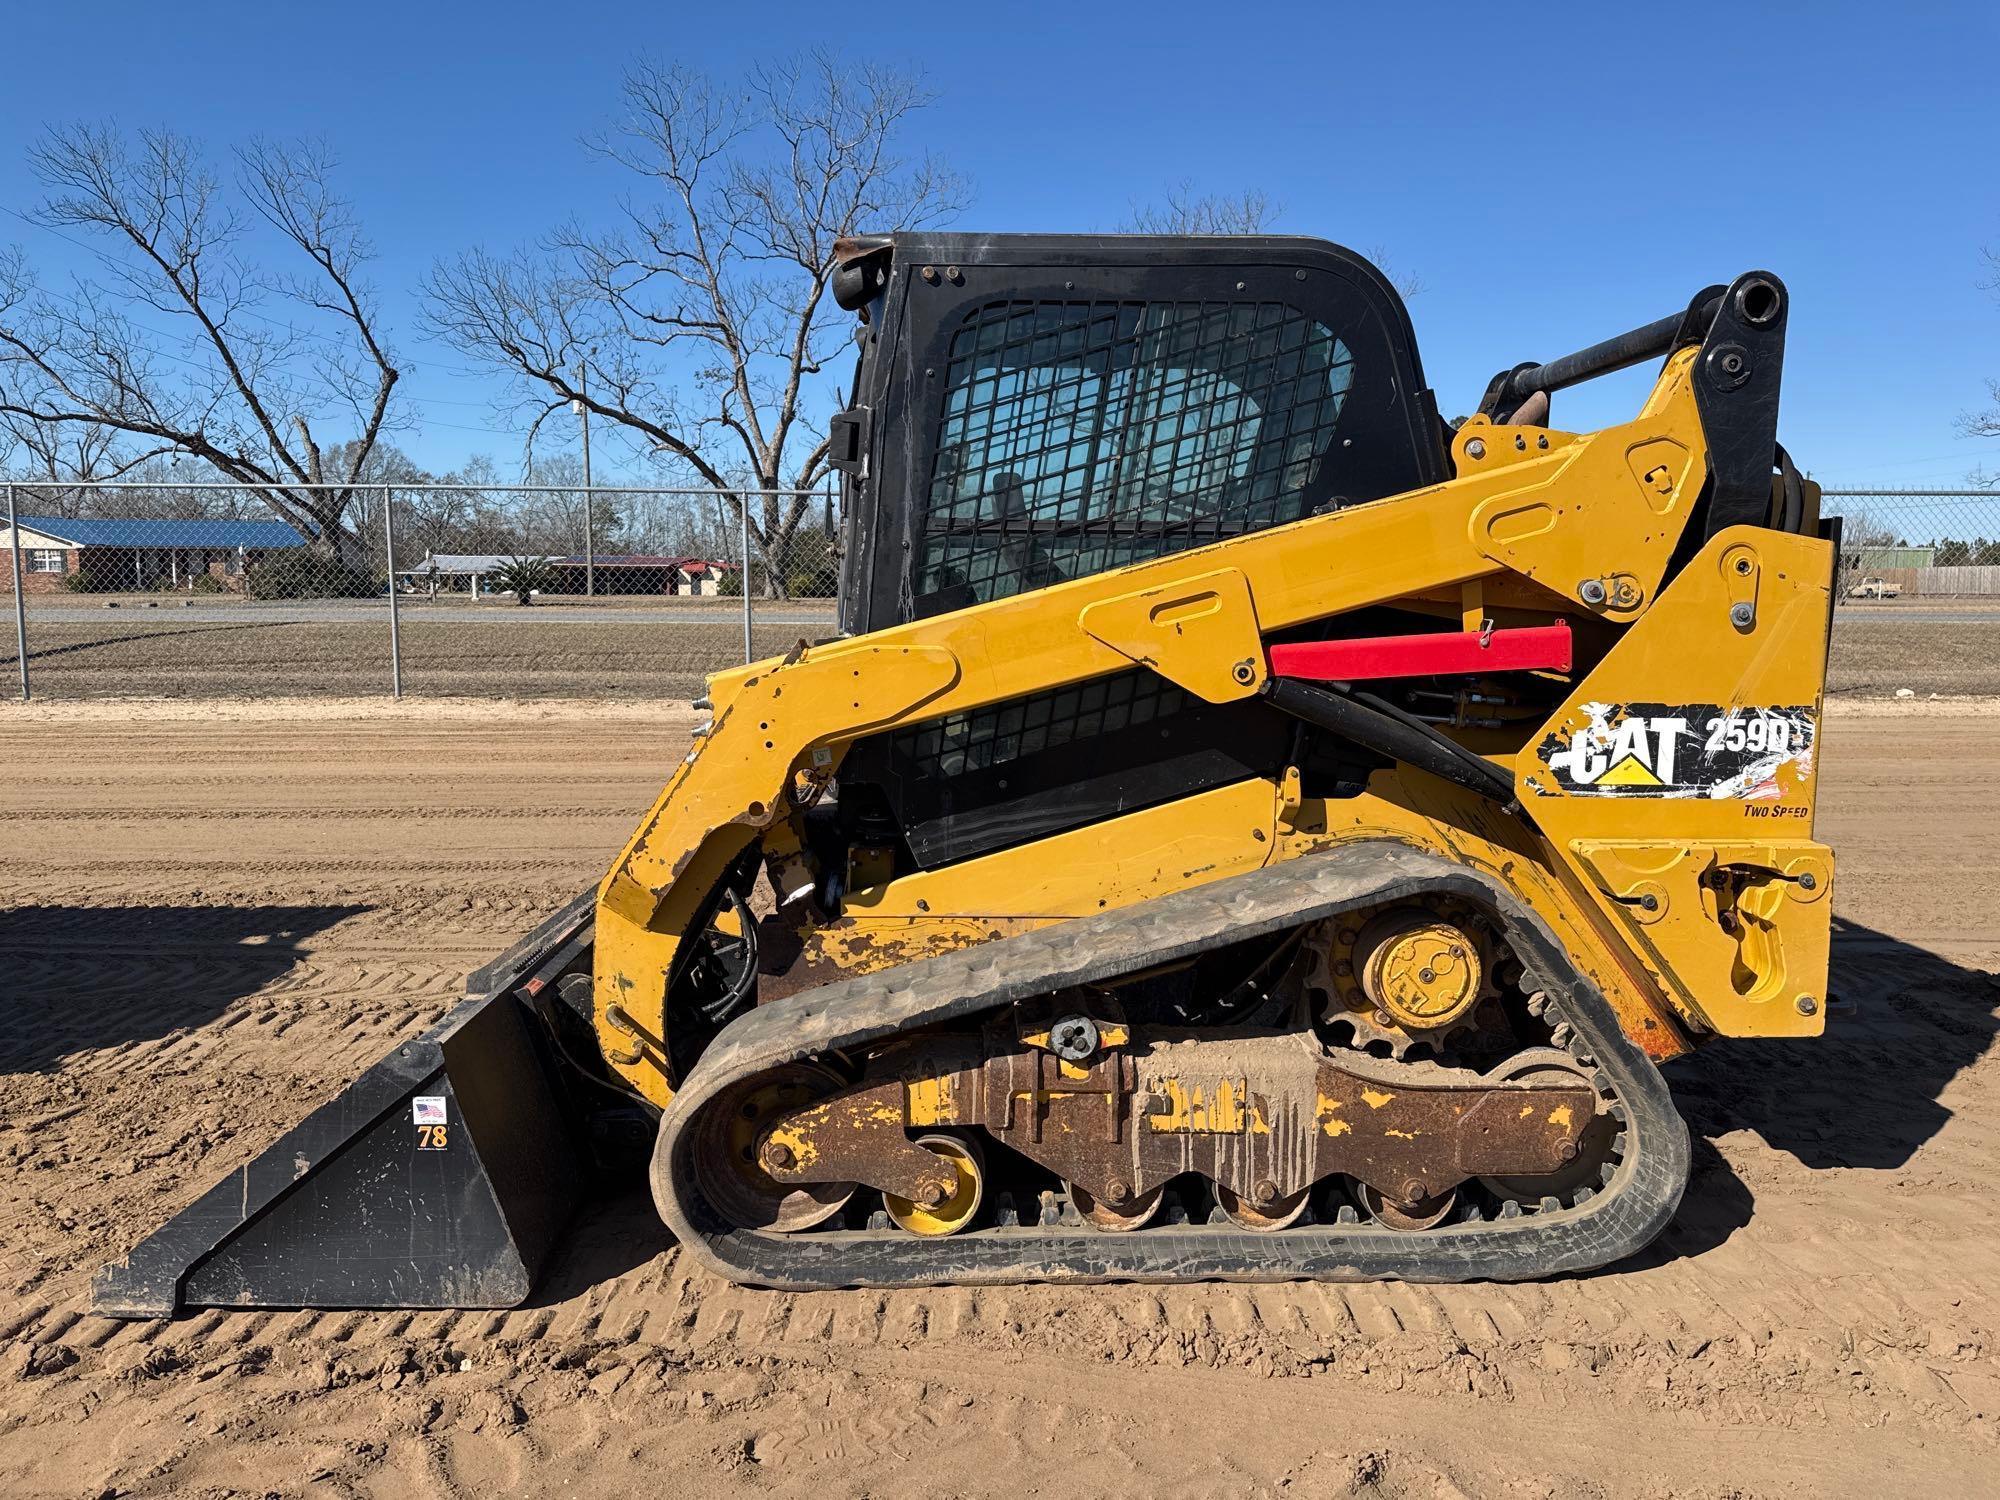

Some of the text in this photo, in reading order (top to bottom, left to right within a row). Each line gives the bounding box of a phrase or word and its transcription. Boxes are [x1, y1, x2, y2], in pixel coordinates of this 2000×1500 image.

[1569, 718, 1789, 784] CAT 259D
[1744, 804, 1769, 818] TWO
[417, 1125, 448, 1147] 78
